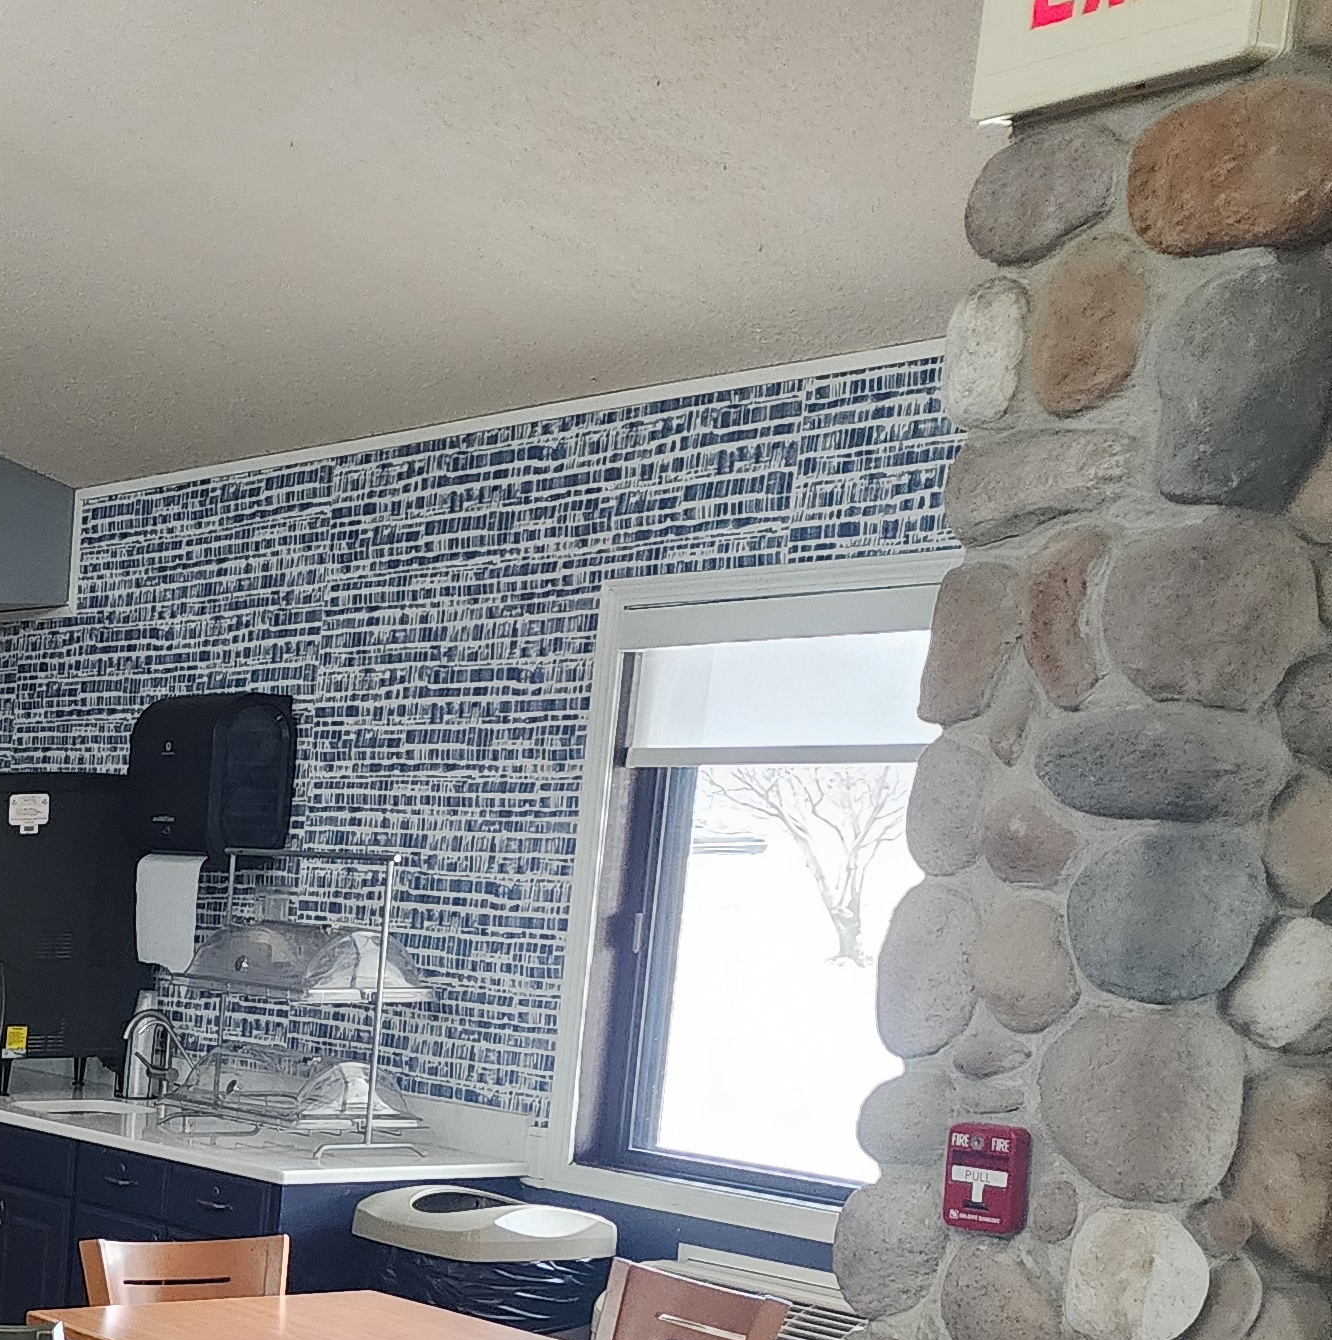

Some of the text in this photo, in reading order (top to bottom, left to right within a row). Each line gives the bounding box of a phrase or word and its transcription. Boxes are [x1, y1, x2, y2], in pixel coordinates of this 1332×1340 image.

[951, 1132, 970, 1148] FIRE
[991, 1137, 1010, 1153] FIRE
[964, 1169, 991, 1184] PULL
